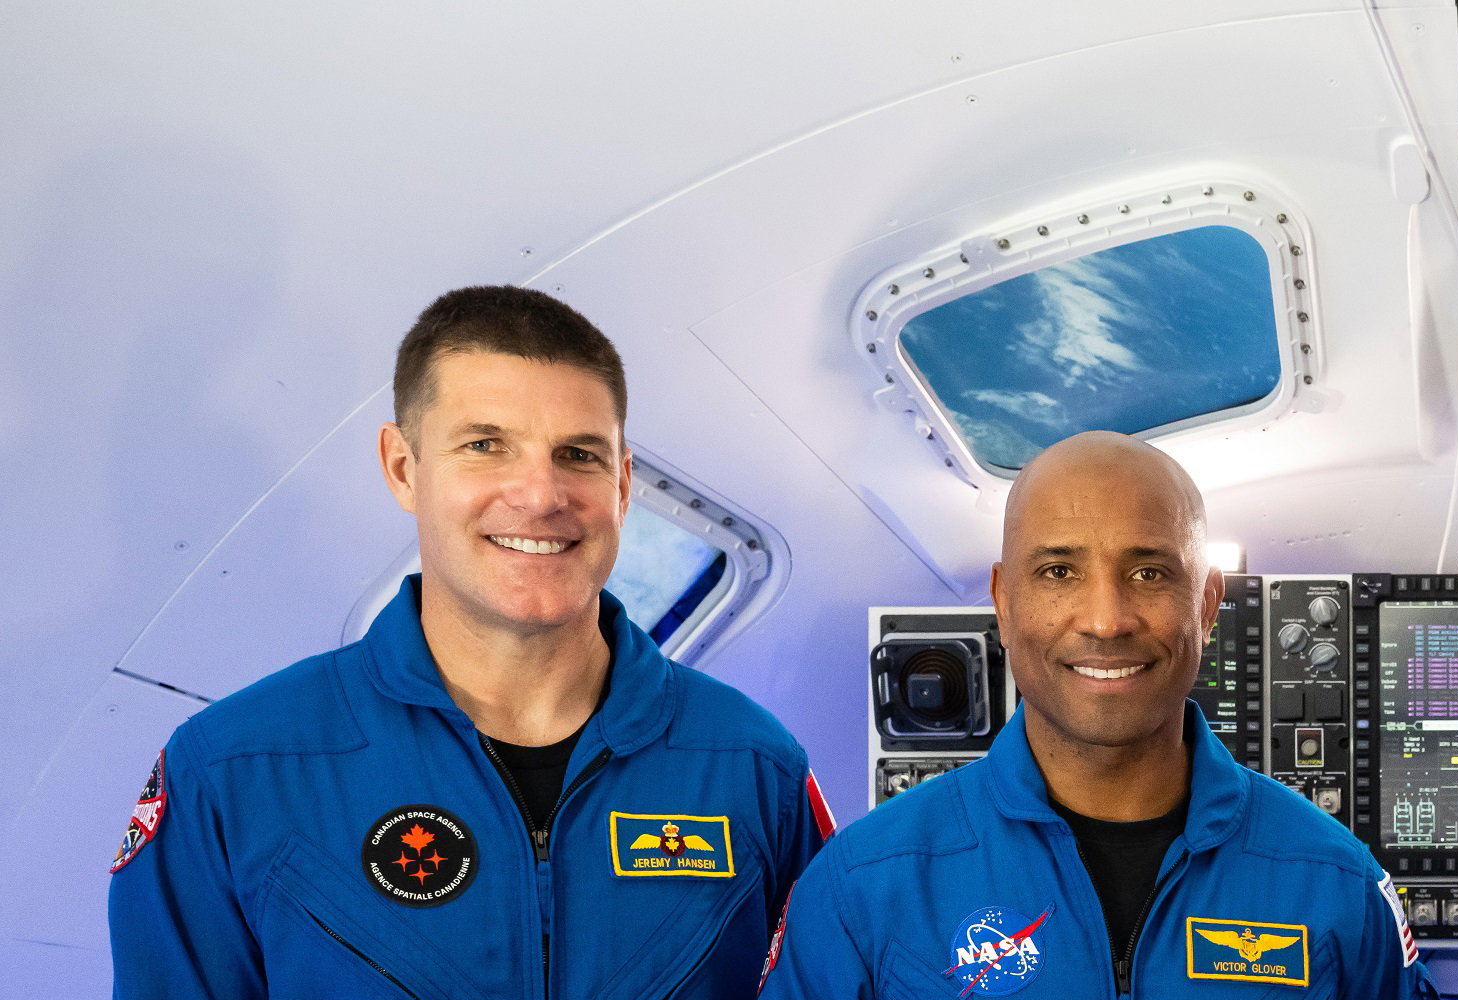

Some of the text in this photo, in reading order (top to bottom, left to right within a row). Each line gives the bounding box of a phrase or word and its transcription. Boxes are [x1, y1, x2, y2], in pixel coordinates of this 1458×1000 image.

[371, 811, 466, 845] CANADIAN SPACE AGENCY
[370, 857, 471, 900] AGENCE SPATIALE CANADIENNE
[633, 858, 716, 869] JEREMY HANSEN
[956, 936, 1040, 967] NASA
[1213, 961, 1287, 976] VICTOR GLOVER
